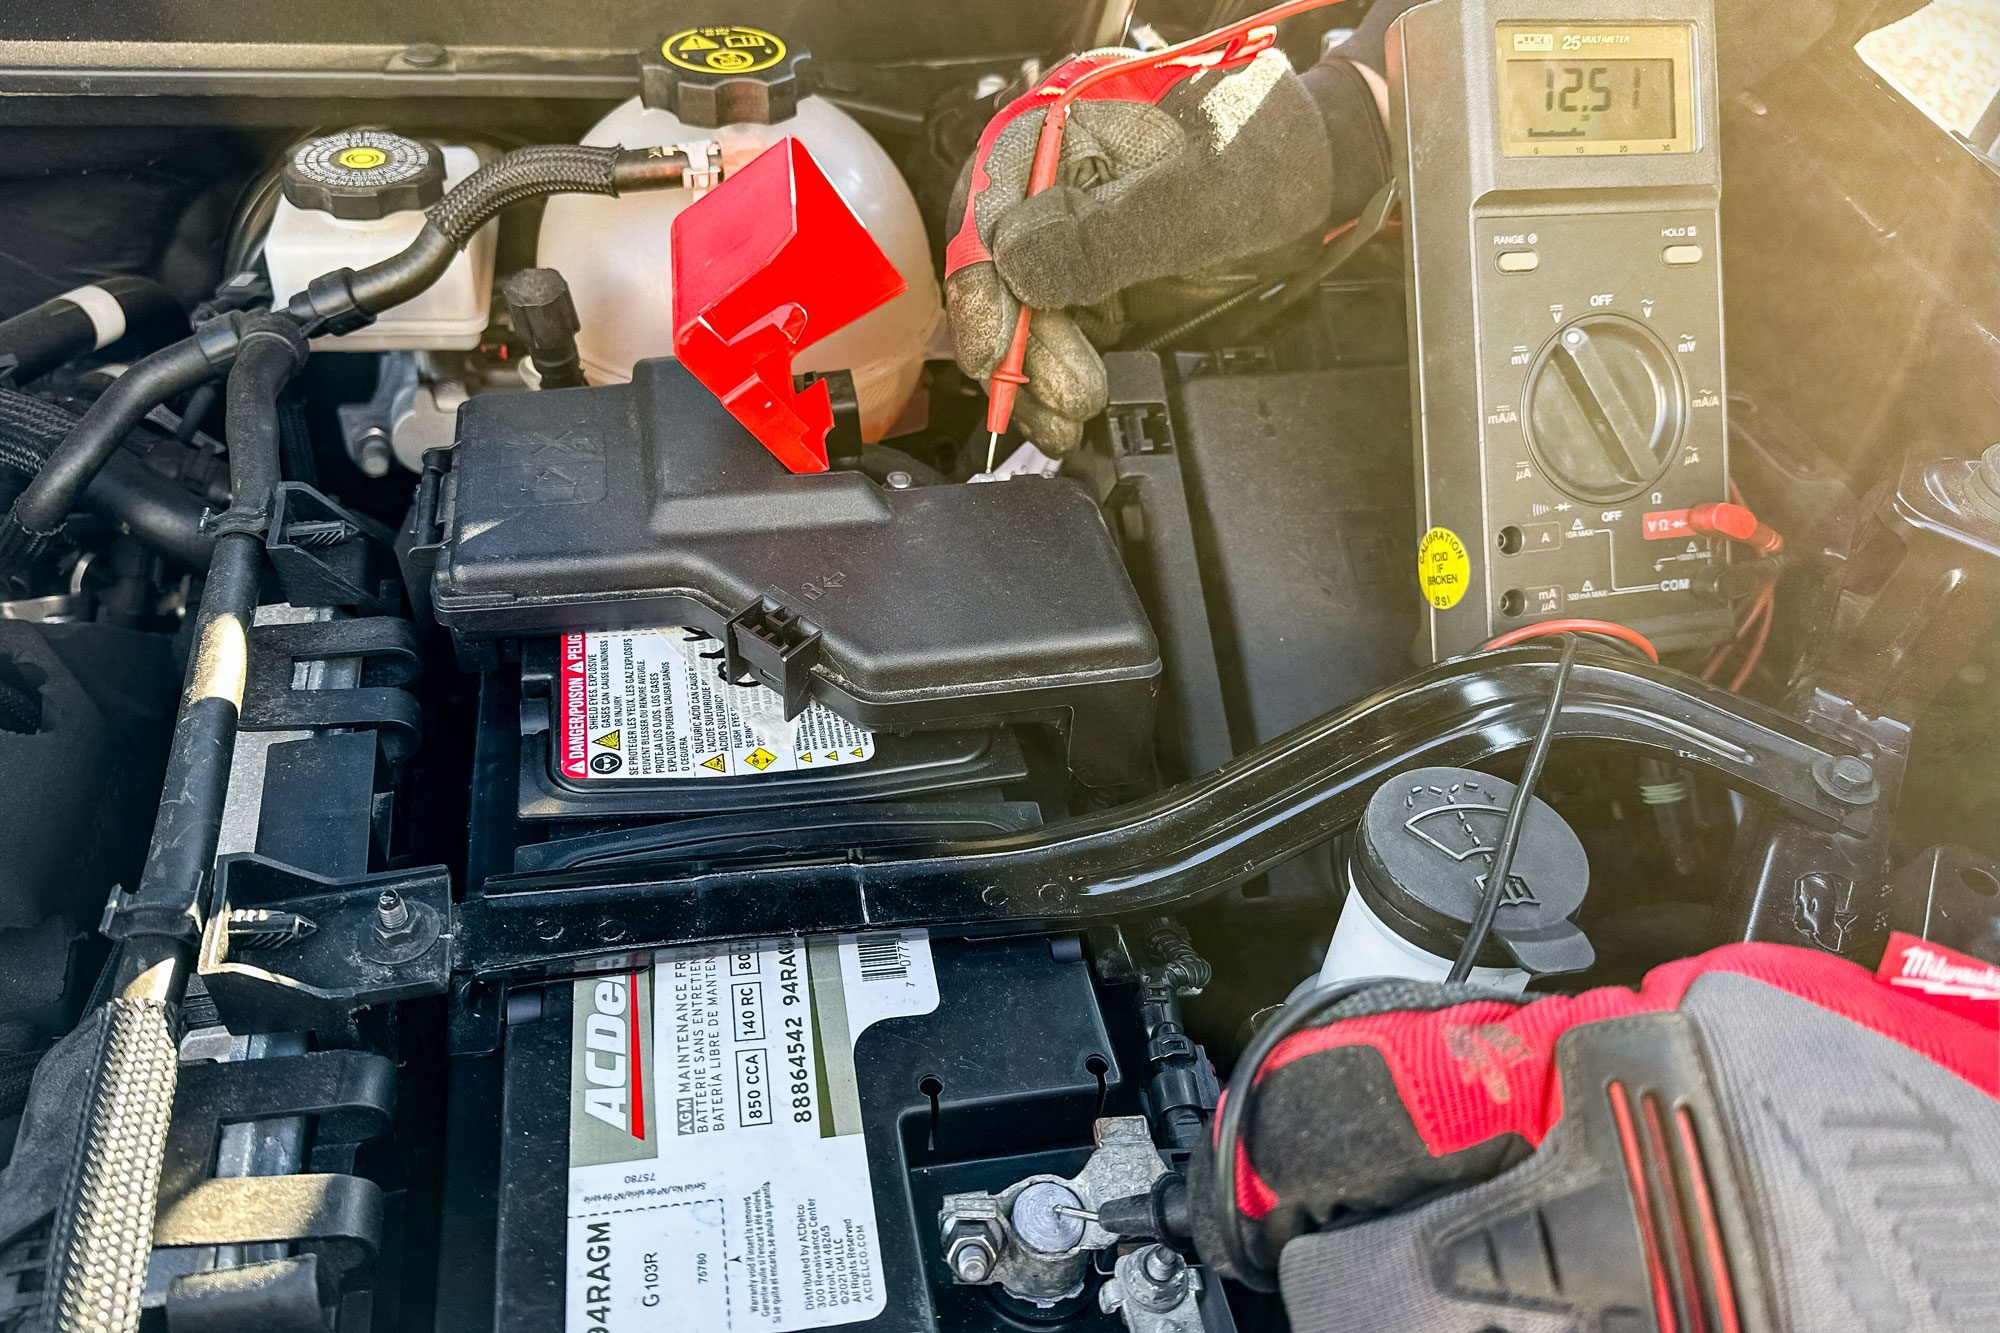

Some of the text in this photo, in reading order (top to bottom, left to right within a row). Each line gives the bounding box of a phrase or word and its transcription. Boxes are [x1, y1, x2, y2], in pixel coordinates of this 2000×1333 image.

[1561, 35, 1581, 51] 25
[1618, 145, 1628, 154] 20
[1661, 144, 1671, 152] 30
[1493, 235, 1524, 245] RANGE
[1661, 228, 1685, 237] HOLD
[1589, 294, 1613, 307] OFF
[1678, 340, 1696, 353] mV
[1511, 353, 1530, 366] mV
[1692, 396, 1720, 408] mA/A
[1487, 411, 1518, 425] mA/A
[1601, 510, 1623, 523] OFF
[1541, 531, 1550, 543] A
[1580, 529, 1595, 538] MAX
[1419, 531, 1465, 565] CALIBRATION
[1431, 552, 1449, 563] VOID
[1427, 573, 1459, 586] BROKEN
[1660, 577, 1691, 592] COM
[1538, 588, 1556, 601] mA
[1591, 589, 1608, 599] MAX
[623, 638, 633, 670] EXPLOSIFS
[588, 654, 598, 686] EXPLOSIVE
[625, 671, 634, 683] GAZ
[600, 640, 611, 728] GASES CAN CAUSE BLINDNESS
[689, 672, 699, 690] CAUSE
[567, 634, 585, 759] DANGER/POISON PELIG
[625, 685, 635, 696] LES
[691, 691, 700, 704] CAN
[614, 695, 623, 726] OR INJURY.
[691, 705, 701, 720] ACID
[702, 687, 714, 726] SULFURIQUE
[589, 707, 598, 730] SHIELD
[627, 718, 637, 729] LES
[637, 660, 651, 774] PEUVENT BLESSER OU RENDRE AVEUGLE.
[650, 672, 665, 773] PROTEJA LOS OJOS. LOS GASES
[660, 662, 677, 772] EXPLOSIVOS PUEDEN CAUSAR DAÑOS
[731, 713, 740, 727] EYES
[693, 721, 704, 754] SULFURIC
[706, 728, 717, 753] L'ACIDE
[733, 730, 743, 748] FLUSH
[745, 740, 755, 748] SE
[625, 731, 638, 765] PROTÉGER
[679, 735, 689, 765] CEGUERA.
[629, 767, 639, 776] SE
[706, 1010, 719, 1026] DE
[740, 987, 756, 1036] 140 RC
[675, 960, 694, 1135] AGM MAINTENANCE FR
[688, 958, 708, 1133] BATTERIE SANS ENTRETIEN
[707, 1031, 721, 1069] LIBRE
[784, 1016, 812, 1123] 88864542
[745, 1054, 762, 1120] 850 CCA
[708, 1073, 725, 1131] BATERÍA
[624, 1172, 656, 1184] 75780
[765, 1218, 775, 1238] anula
[745, 1235, 755, 1256] insert
[767, 1239, 775, 1247] se
[833, 1238, 844, 1255] LLC
[796, 1204, 815, 1311] Distributed by ACDelco
[807, 1197, 826, 1308] 300 Renaissance Center
[843, 1218, 862, 1303] All Rights Reserved
[746, 1263, 756, 1278] void
[825, 1257, 836, 1269] MI
[834, 1256, 846, 1272] GM
[856, 1224, 874, 1302] ACDELCO.COM
[758, 1267, 768, 1285] nulle
[749, 1279, 760, 1313] Warranty
[770, 1286, 782, 1305] quita
[825, 1270, 839, 1307] Detroit,
[759, 1287, 771, 1317] Garantie
[772, 1306, 781, 1315] se
